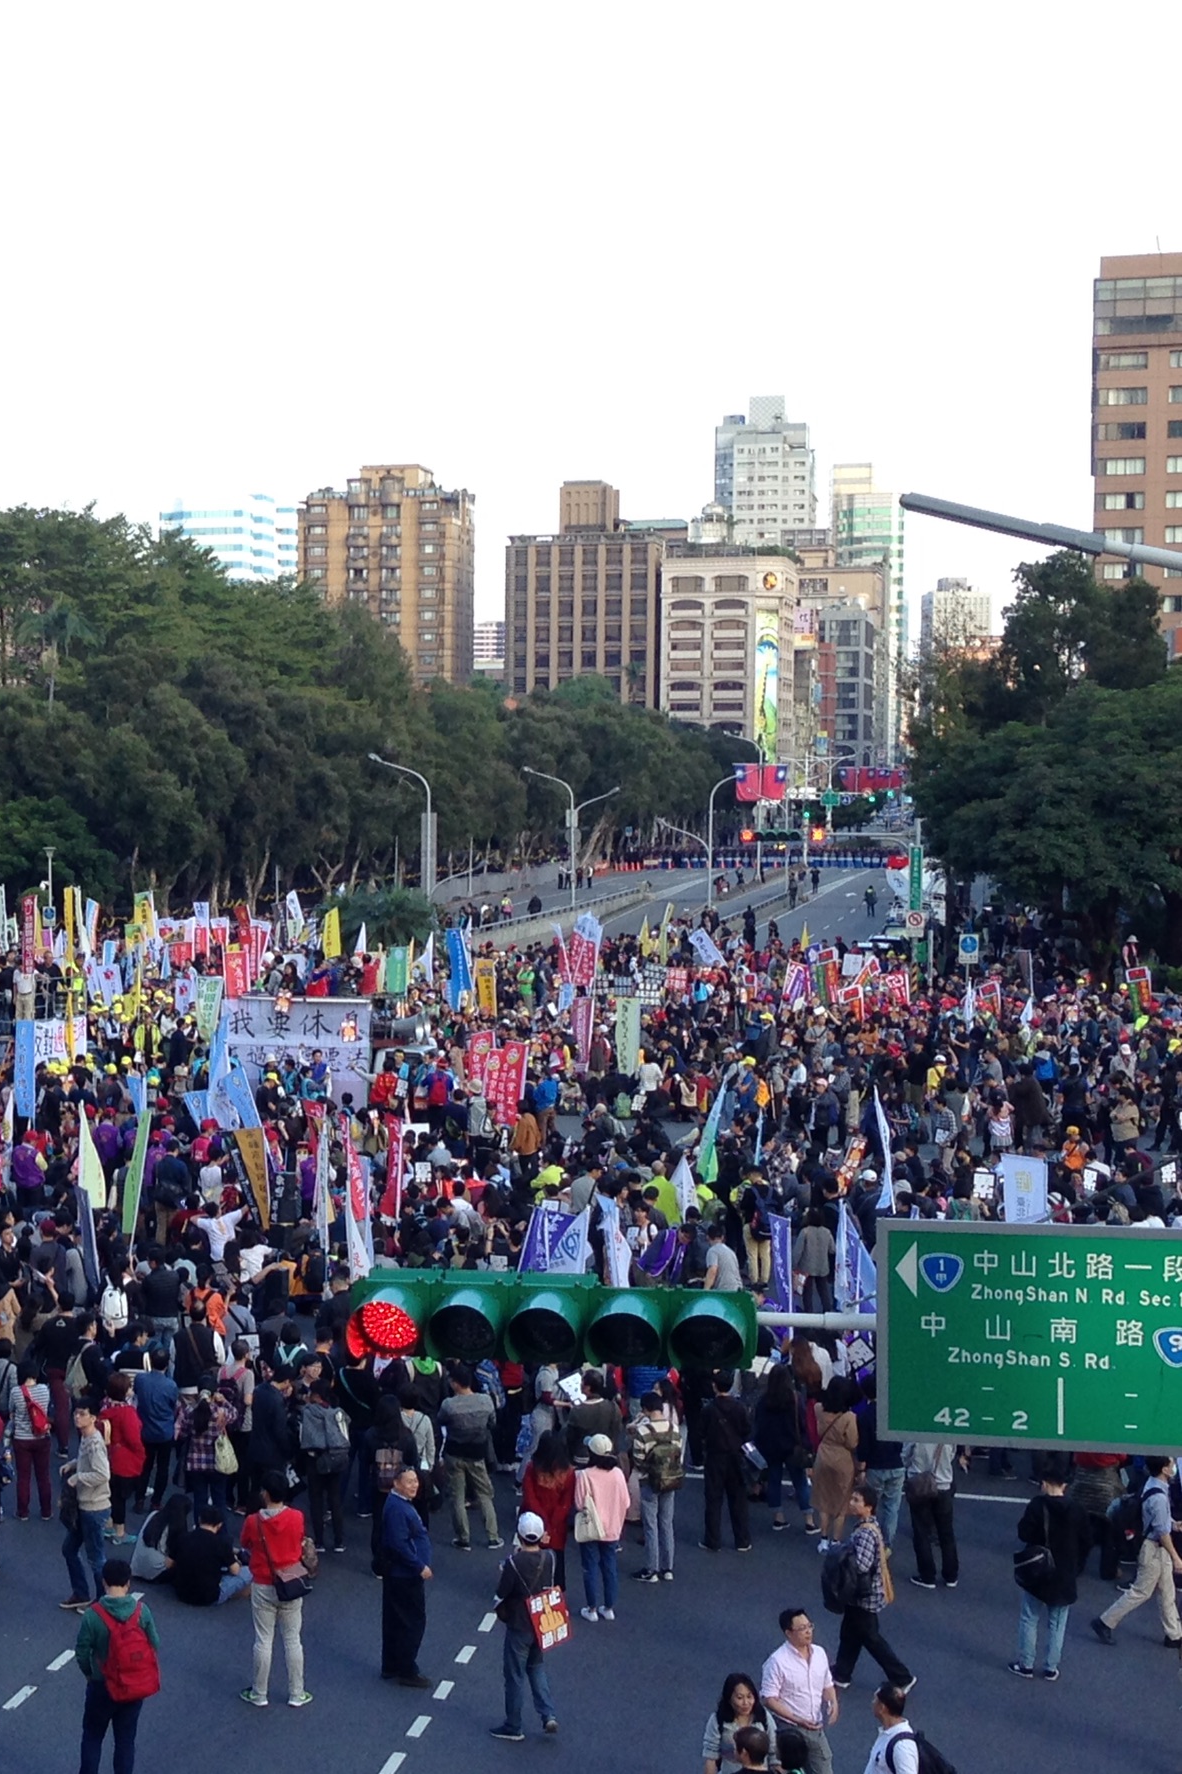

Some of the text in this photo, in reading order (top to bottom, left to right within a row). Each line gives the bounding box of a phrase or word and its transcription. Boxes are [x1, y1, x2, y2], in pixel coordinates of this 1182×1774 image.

[971, 1284, 1068, 1306] ZhongShan
[920, 1312, 1145, 1347] 中山南路
[948, 1347, 1051, 1369] ZhongShan
